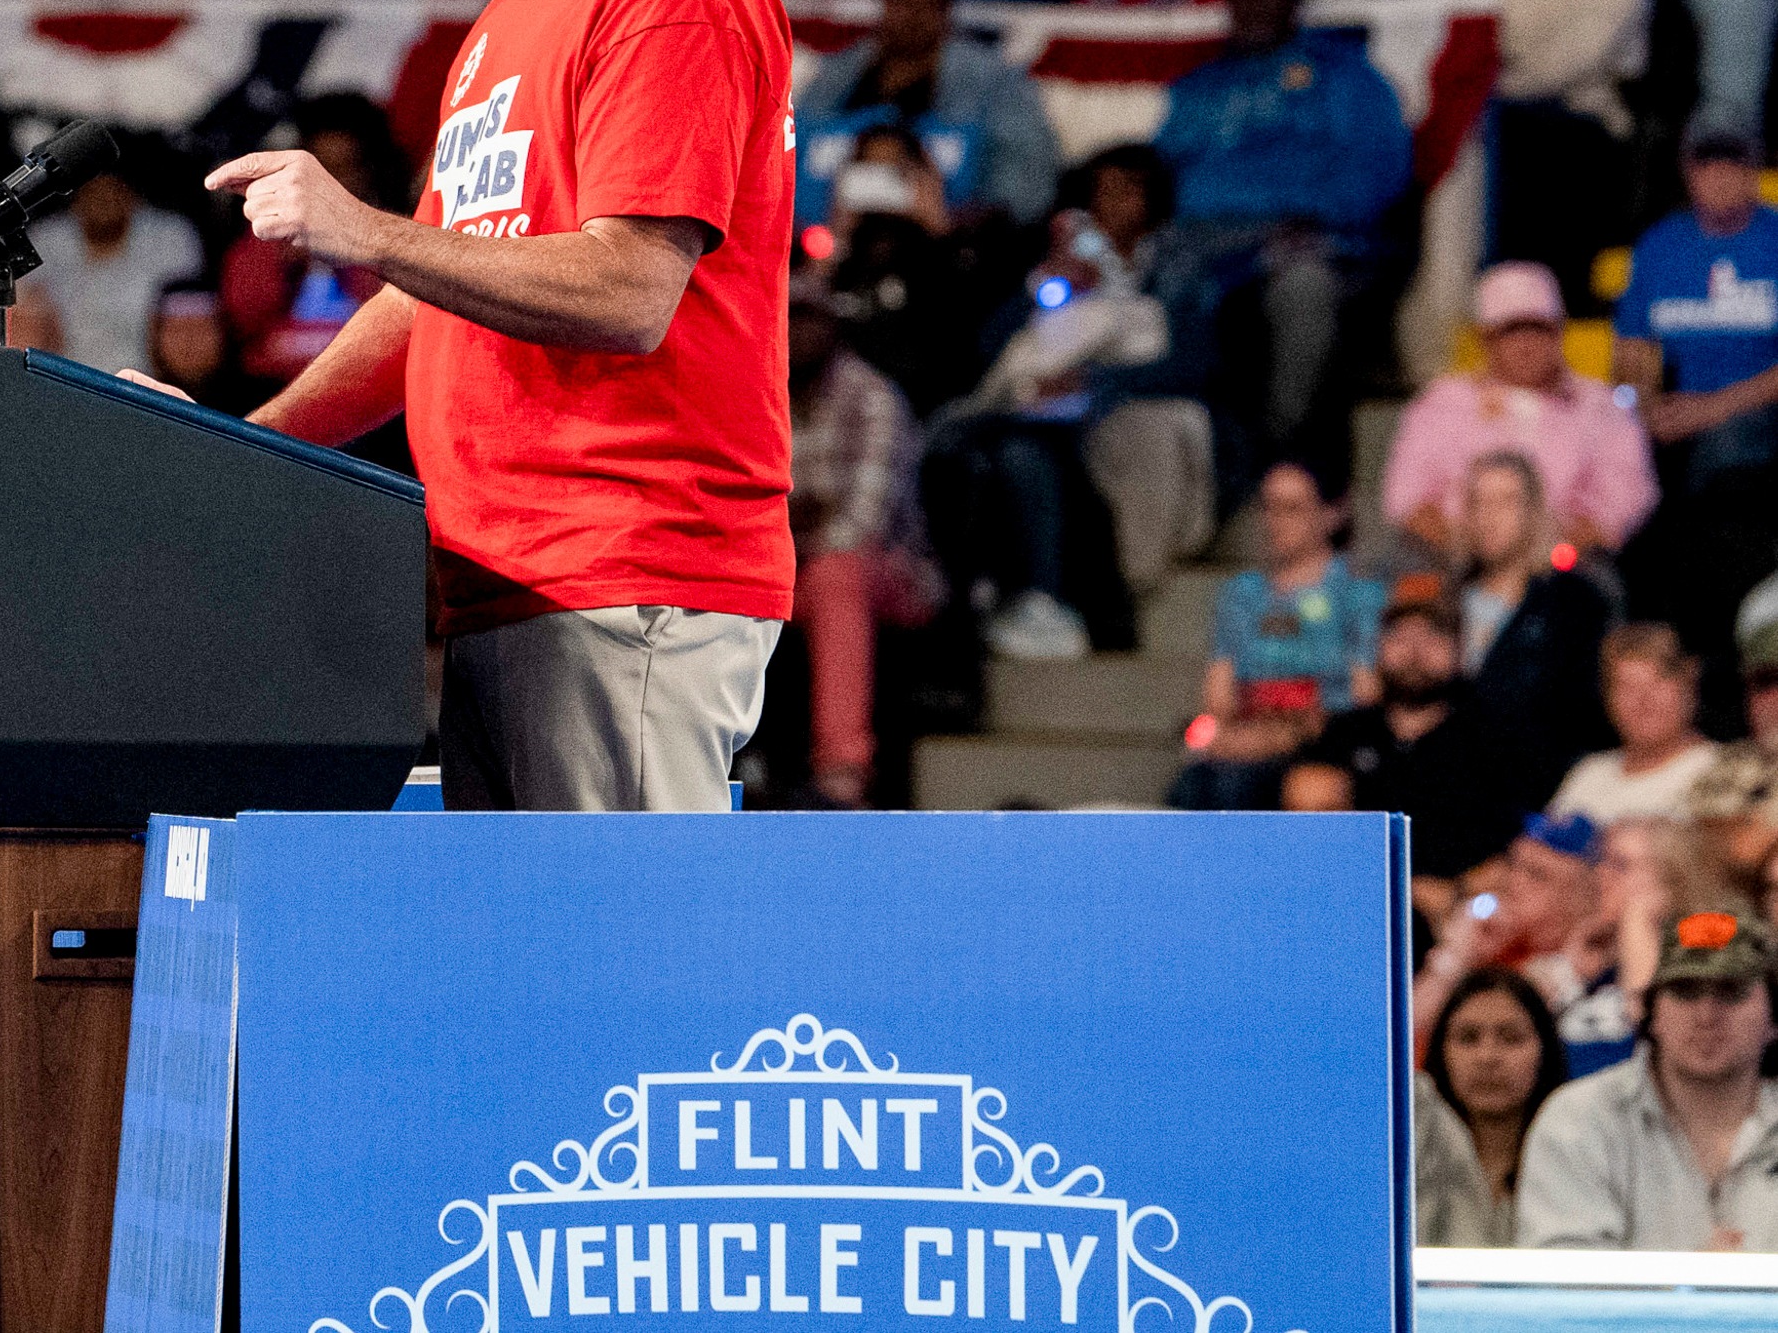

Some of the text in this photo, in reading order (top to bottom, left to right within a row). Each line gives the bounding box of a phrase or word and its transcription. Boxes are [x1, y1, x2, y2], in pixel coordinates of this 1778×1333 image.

[678, 1098, 939, 1171] FLINT
[506, 1223, 1100, 1325] VEHICLE CITY
